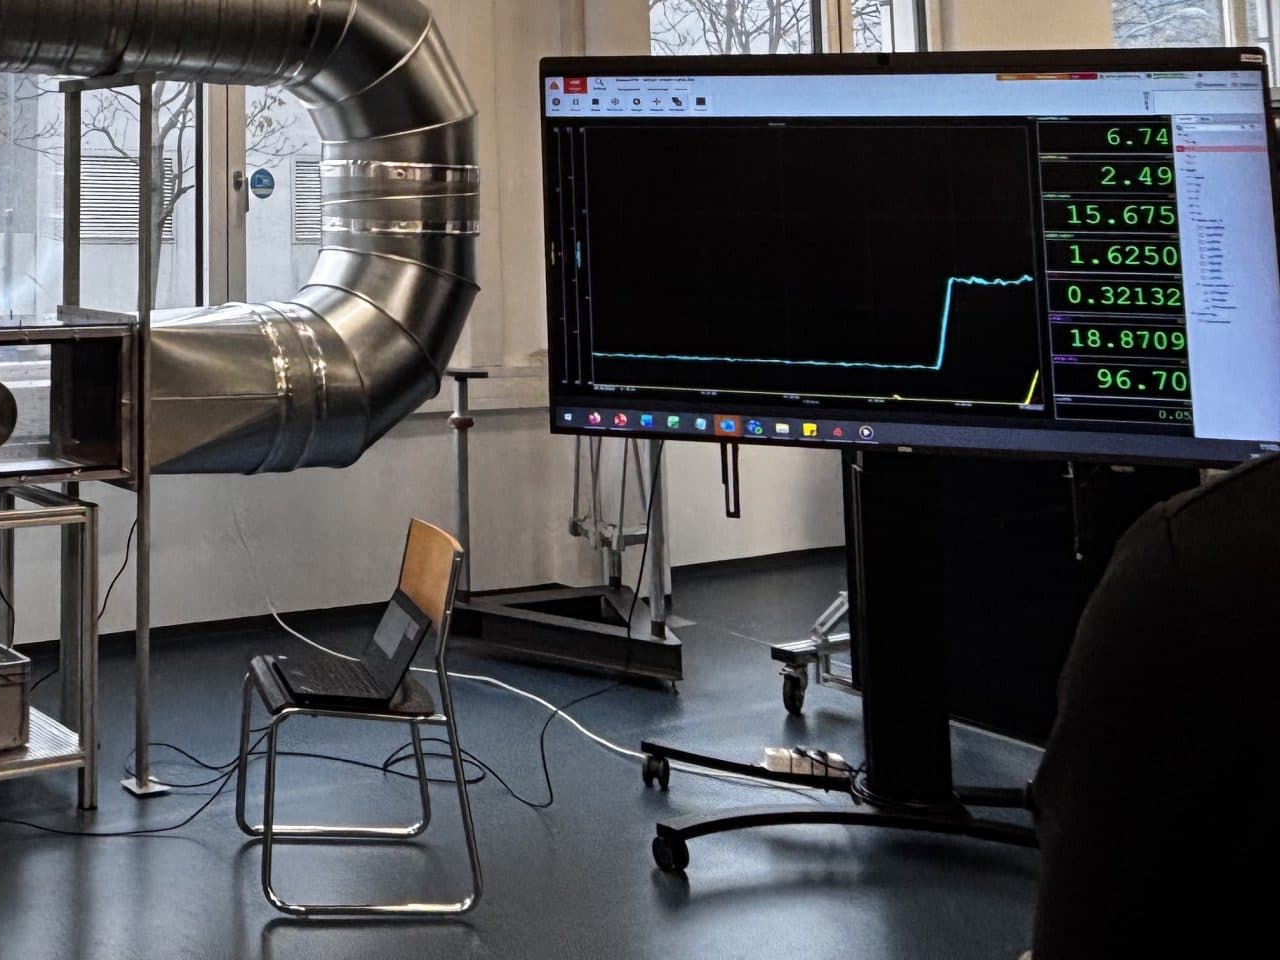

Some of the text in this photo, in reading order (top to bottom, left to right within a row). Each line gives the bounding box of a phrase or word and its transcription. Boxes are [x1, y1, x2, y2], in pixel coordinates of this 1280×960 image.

[1107, 127, 1169, 145] 6.74
[1101, 166, 1172, 185] 2.49
[1067, 204, 1175, 225] 15.675
[1069, 244, 1178, 266] 1.6250
[1067, 285, 1182, 306] 0.32132
[1070, 329, 1185, 351] 18.8709
[1097, 368, 1187, 392] 96.70
